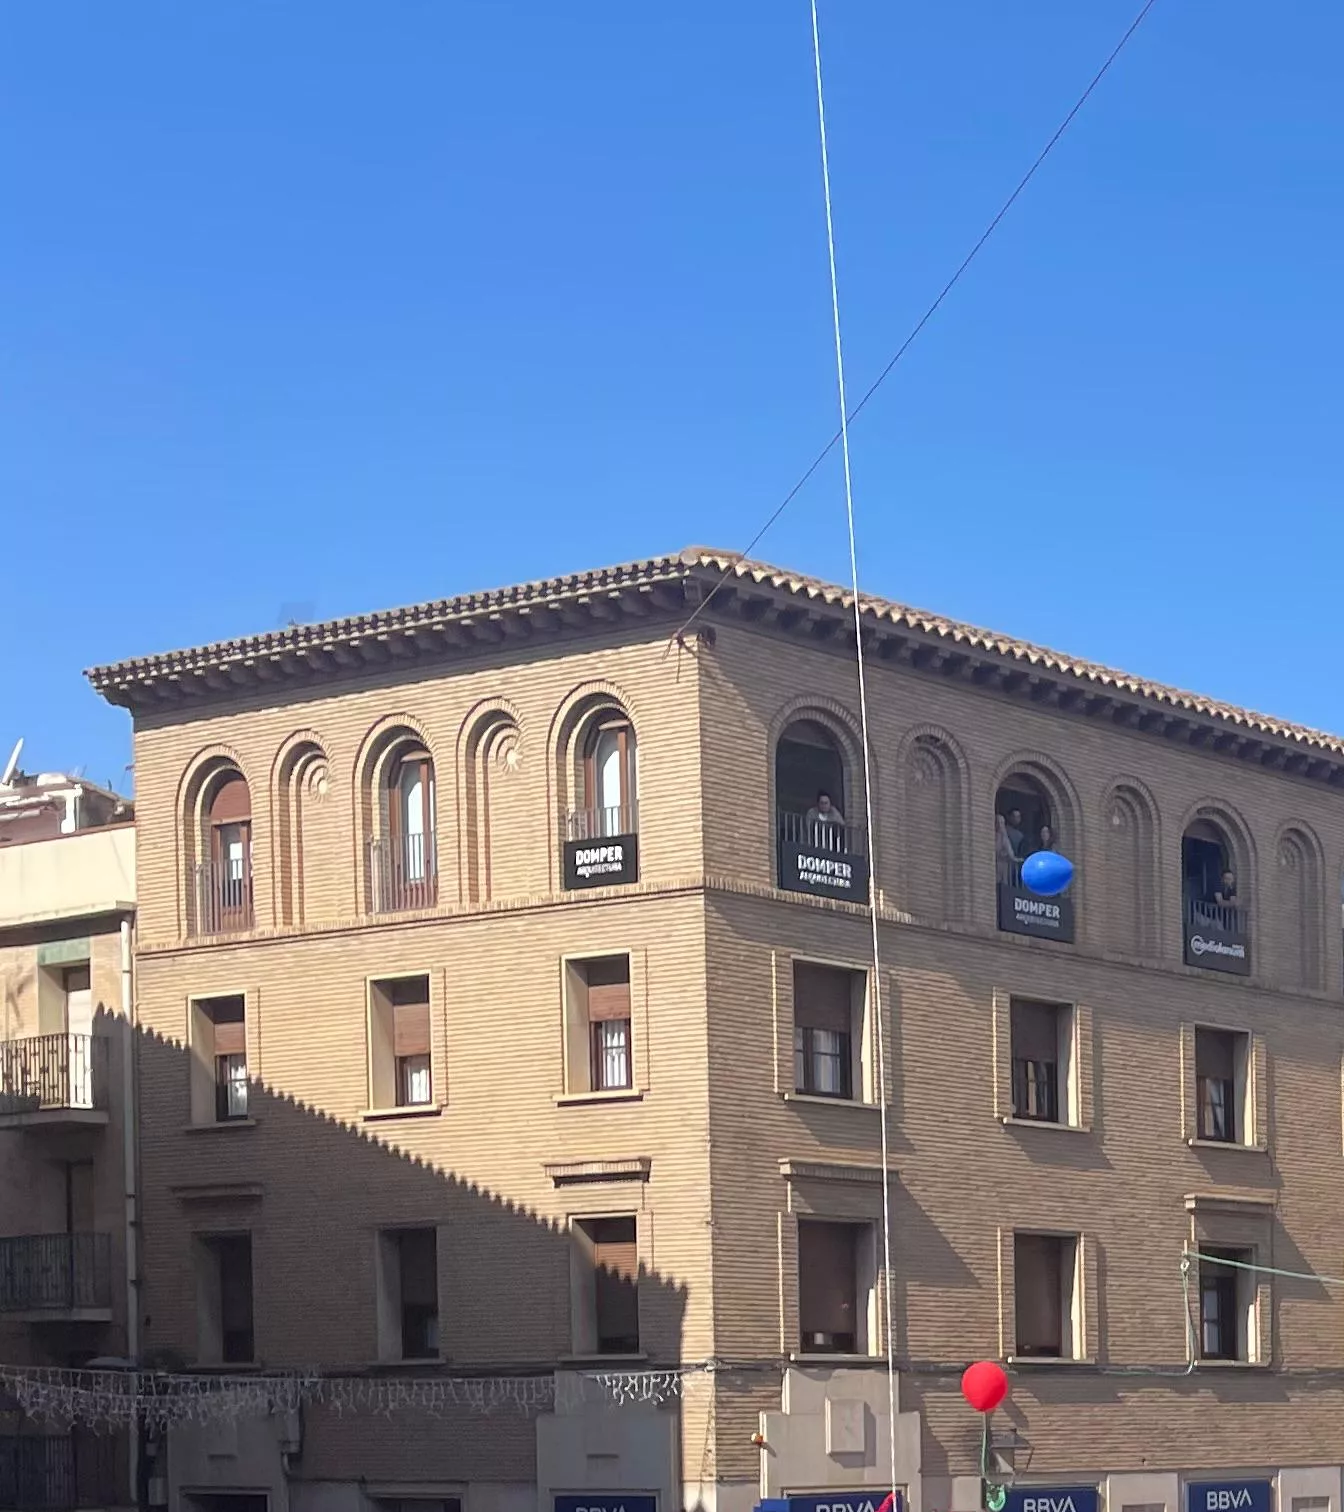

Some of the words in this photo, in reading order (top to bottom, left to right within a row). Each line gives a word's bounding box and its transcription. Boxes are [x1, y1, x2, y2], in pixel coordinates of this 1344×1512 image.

[575, 846, 623, 866] DOMPER
[798, 854, 852, 878] DOMPER
[1014, 897, 1060, 918] DOMPER
[1206, 1487, 1253, 1511] BBVA
